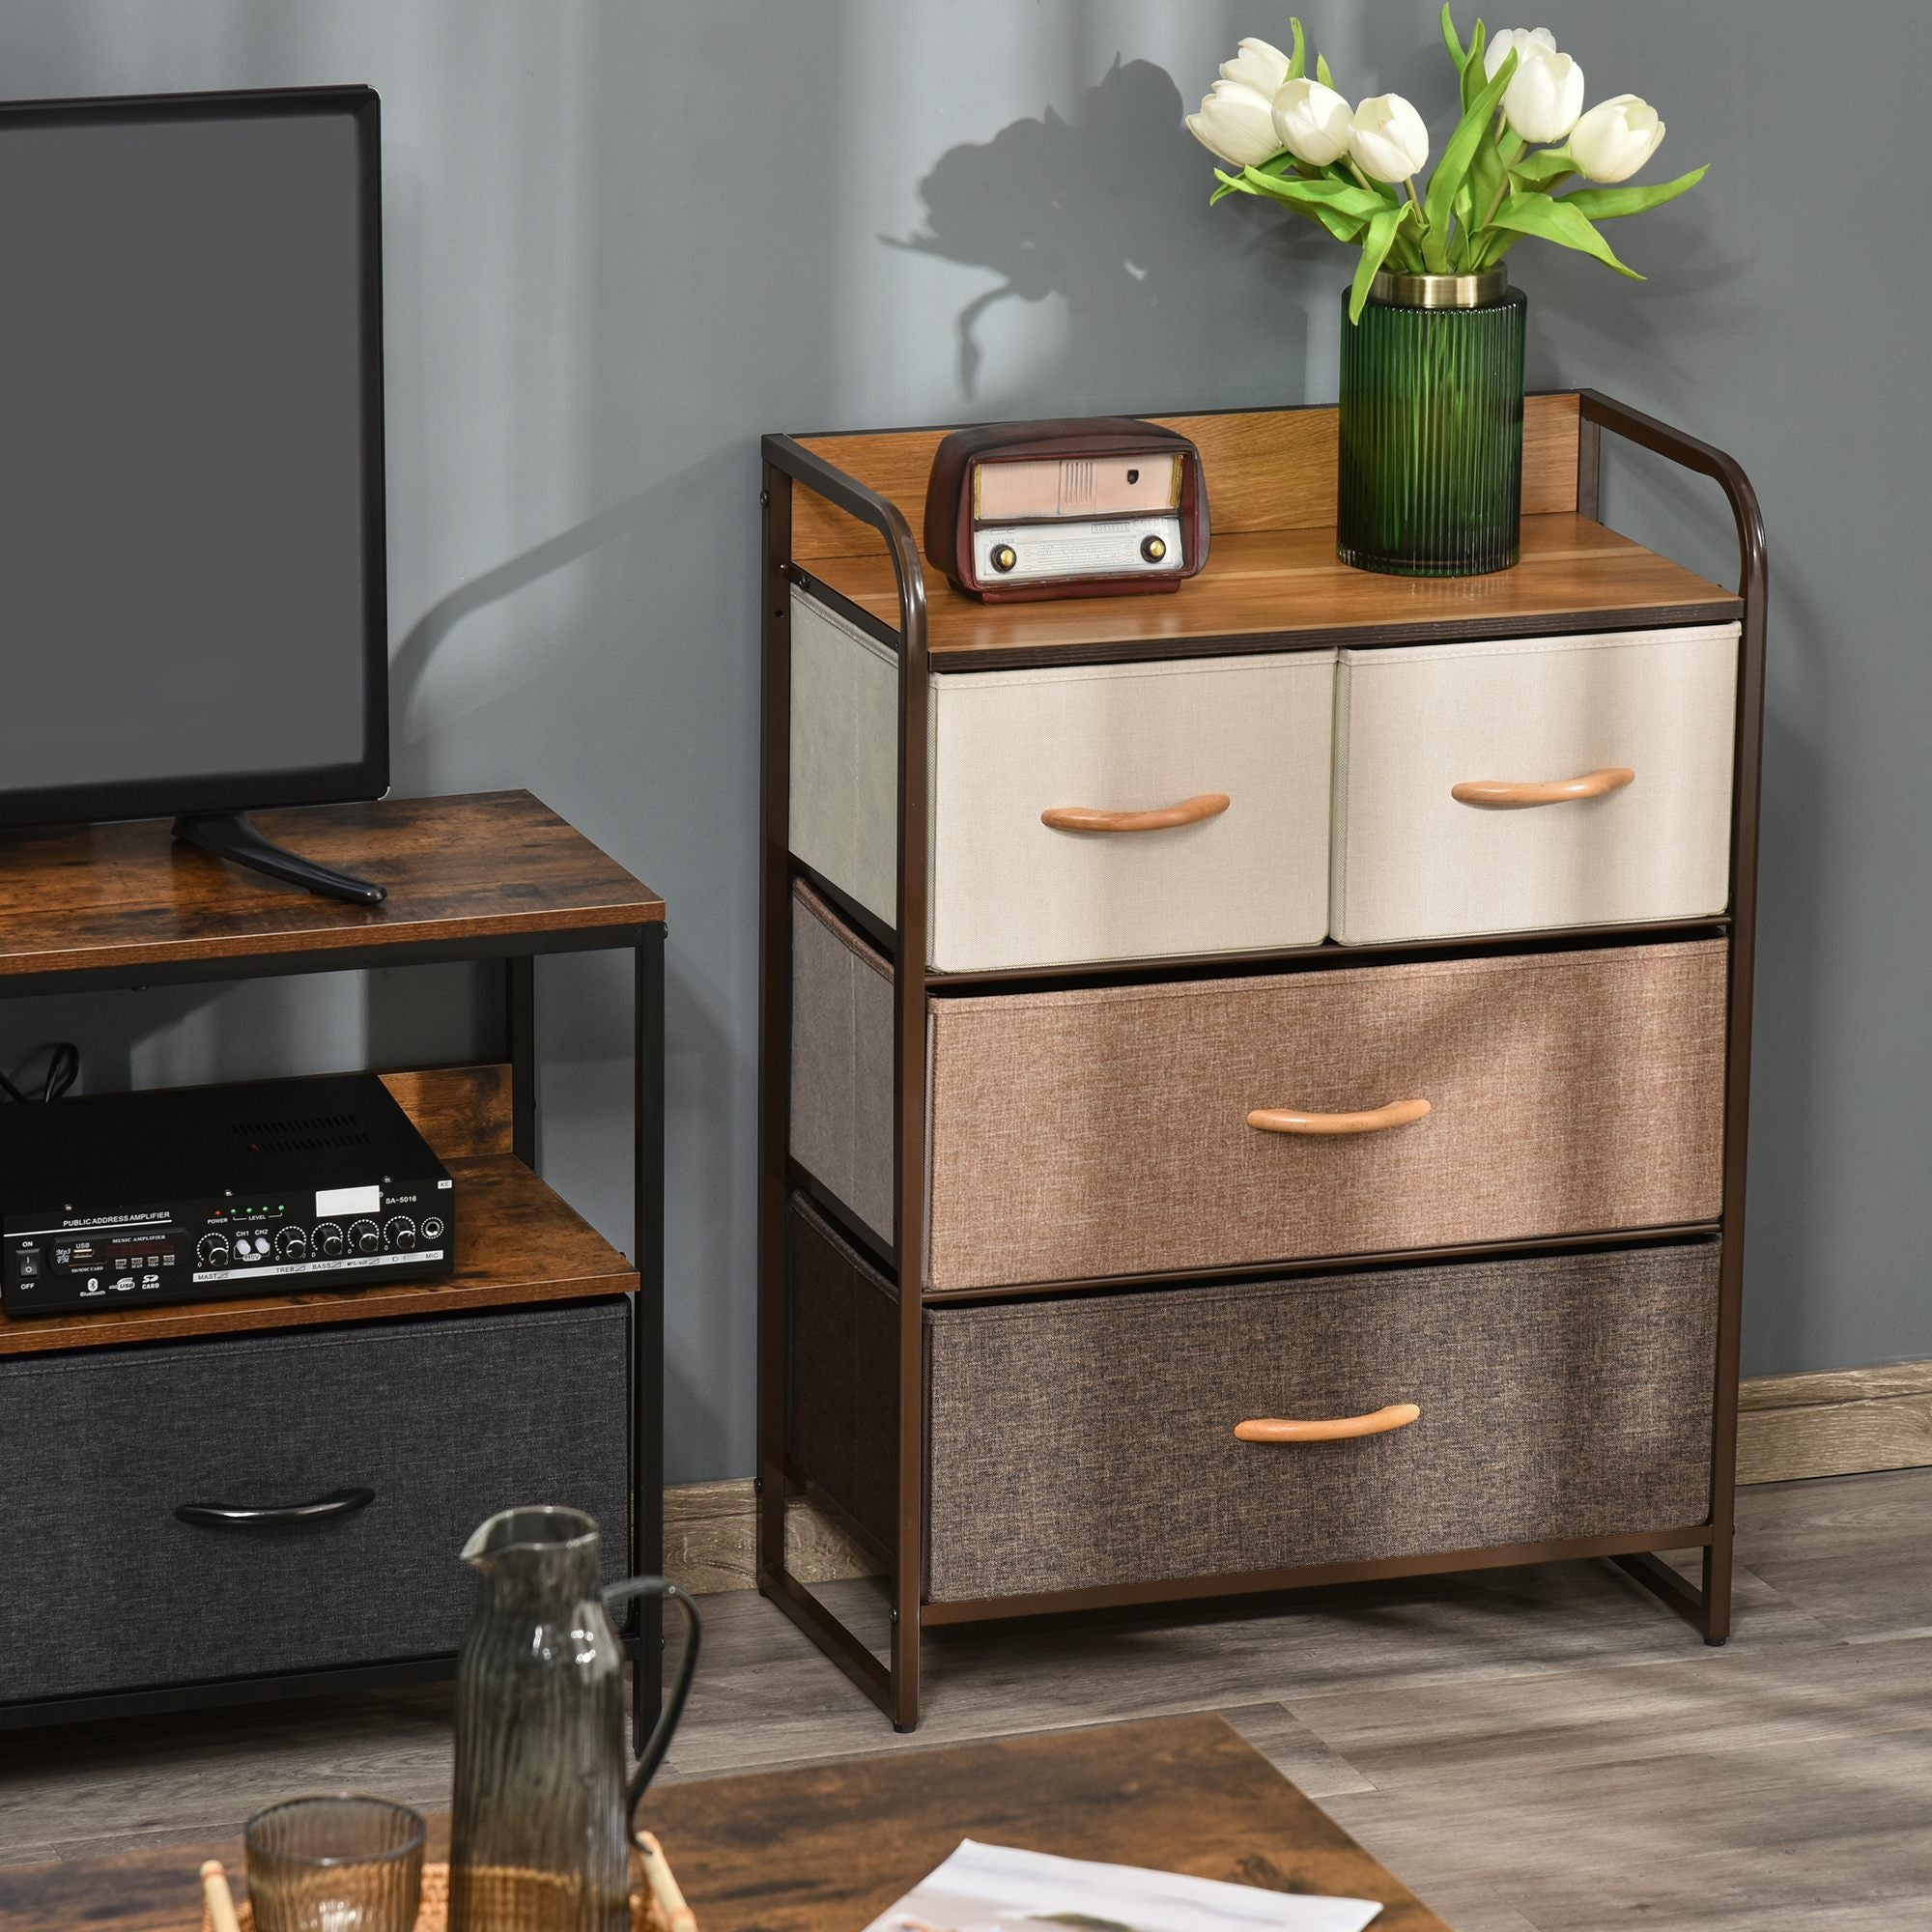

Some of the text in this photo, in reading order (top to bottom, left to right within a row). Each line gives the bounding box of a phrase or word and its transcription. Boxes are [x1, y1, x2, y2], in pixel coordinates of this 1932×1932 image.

[385, 1195, 417, 1205] SA-5016
[63, 1211, 171, 1227] PUBLIC ADDRESS AMPLIFIER
